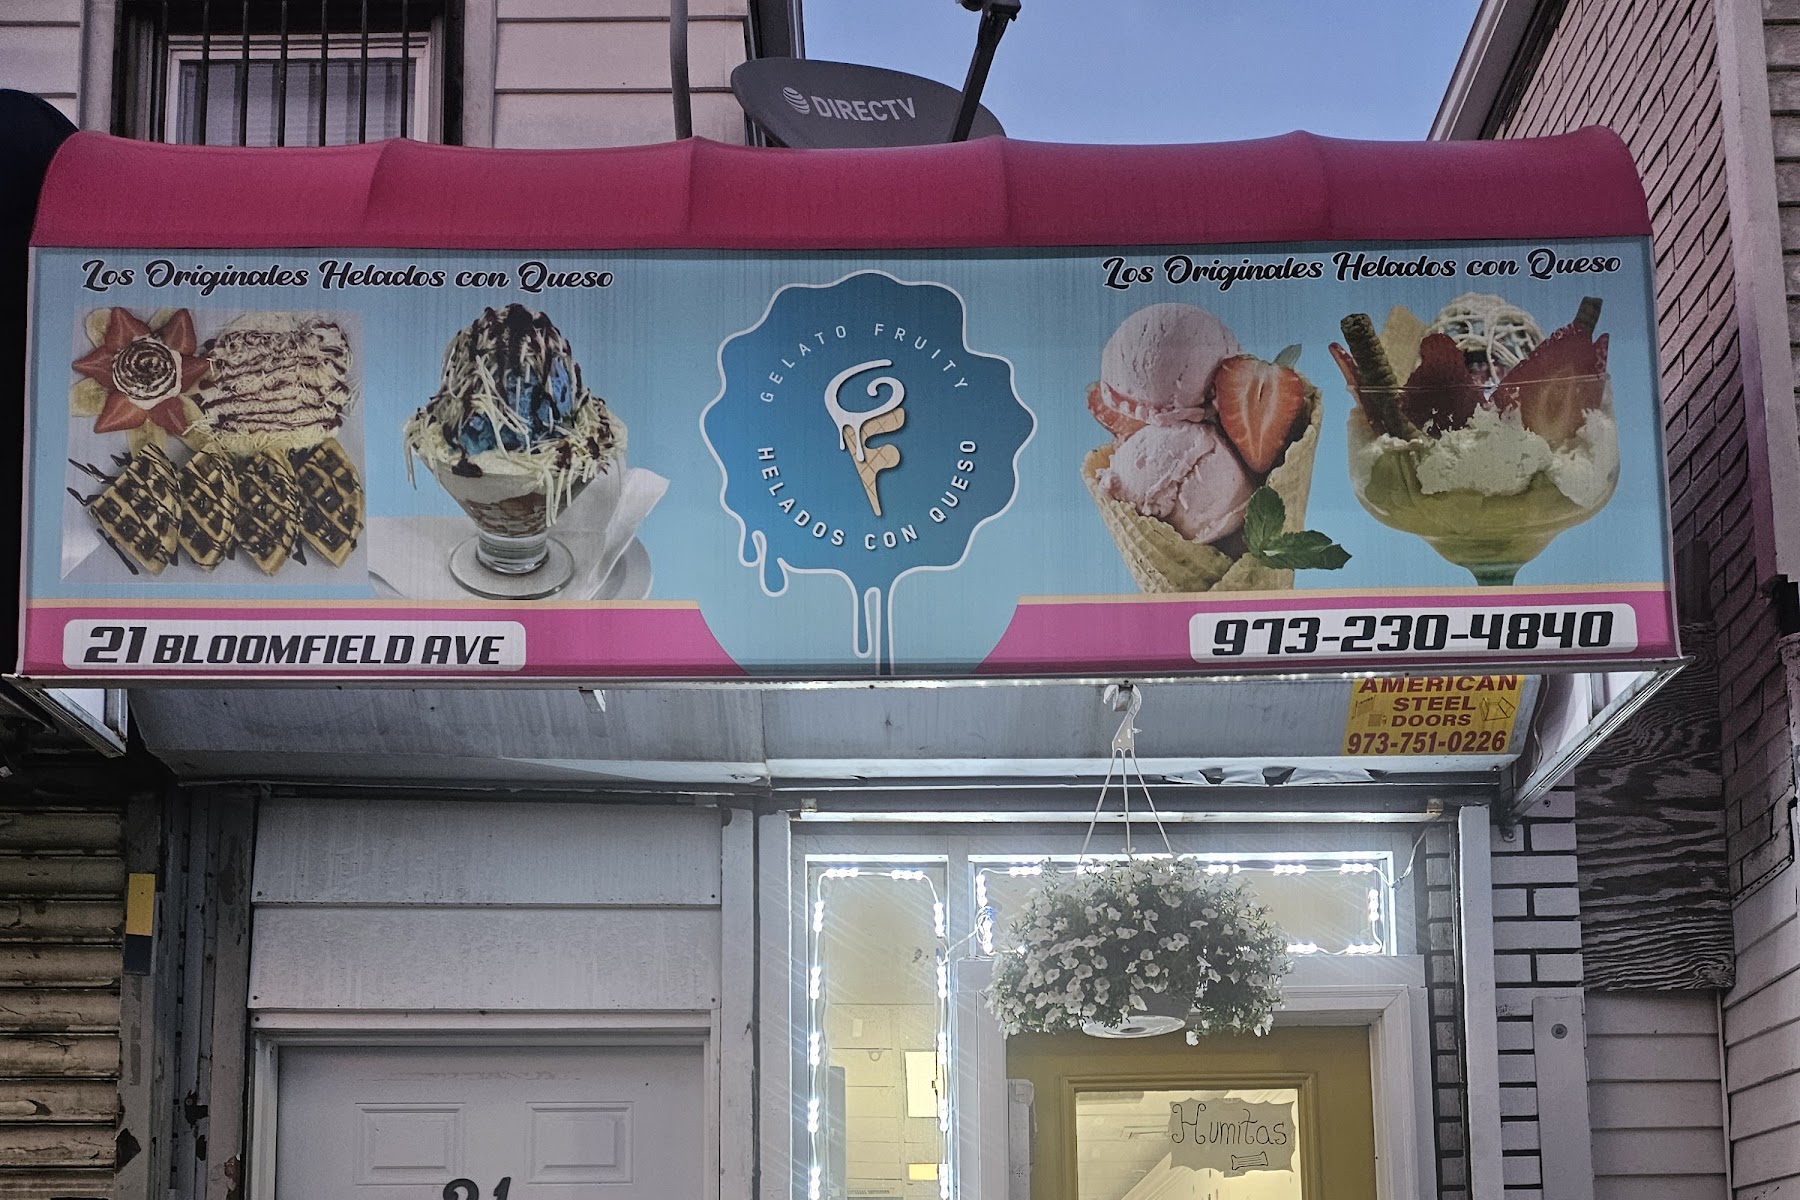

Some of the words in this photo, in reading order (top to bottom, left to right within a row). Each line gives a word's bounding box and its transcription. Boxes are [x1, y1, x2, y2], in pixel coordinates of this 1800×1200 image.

[811, 96, 916, 121] DIRECTV
[82, 259, 135, 292] Los
[145, 259, 309, 296] Originales
[318, 260, 447, 290] Helados
[454, 270, 510, 288] con
[517, 261, 614, 293] Queso
[1102, 256, 1155, 290] Los
[1163, 255, 1324, 292] Originales
[1332, 251, 1457, 282] Helados
[1465, 259, 1520, 277] con
[1527, 248, 1622, 280] Queso
[760, 325, 847, 402] GELATO
[874, 323, 968, 389] FRUITY
[757, 446, 846, 546] HELADOS
[864, 524, 918, 550] CON
[929, 440, 978, 523] QUESO
[83, 626, 147, 664] 21
[152, 635, 415, 664] BLOOMFIELD
[420, 635, 505, 665] AVE
[1212, 611, 1614, 656] 973-230-4840
[1358, 675, 1518, 693] AMERICAN
[1391, 714, 1472, 727] DOORS
[1392, 696, 1476, 711] STEEL
[1347, 730, 1507, 754] 973-751-0226
[1171, 1103, 1288, 1146] Humitas
